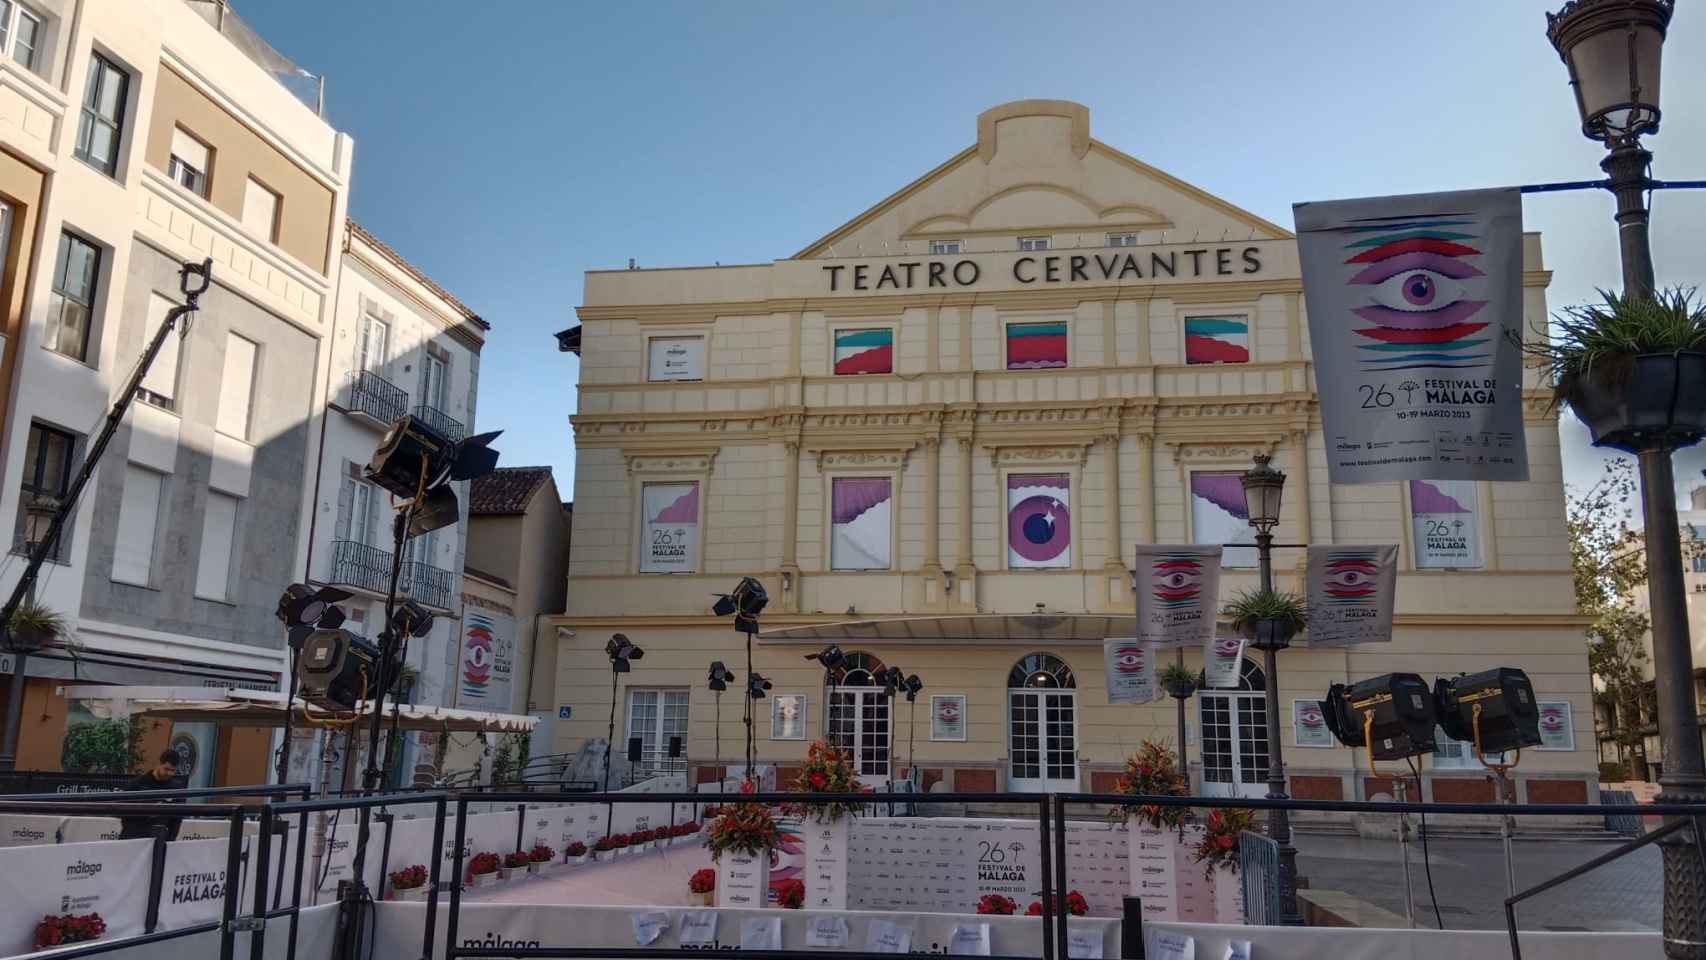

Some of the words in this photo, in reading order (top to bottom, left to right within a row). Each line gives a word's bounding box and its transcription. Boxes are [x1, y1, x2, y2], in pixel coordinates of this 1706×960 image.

[822, 260, 981, 291] TEATRO
[1013, 247, 1262, 283] CERVANTES
[1424, 379, 1479, 389] FESTIVAL
[1484, 379, 1497, 389] DE
[1358, 384, 1395, 408] 26
[1420, 410, 1451, 418] MARZO
[1426, 520, 1449, 537] 26
[653, 529, 673, 545] 26
[12, 828, 45, 840] málaga
[978, 840, 1005, 863] 26
[67, 860, 102, 876] málaga
[174, 873, 217, 885] FESTIVAL
[219, 871, 225, 881] D
